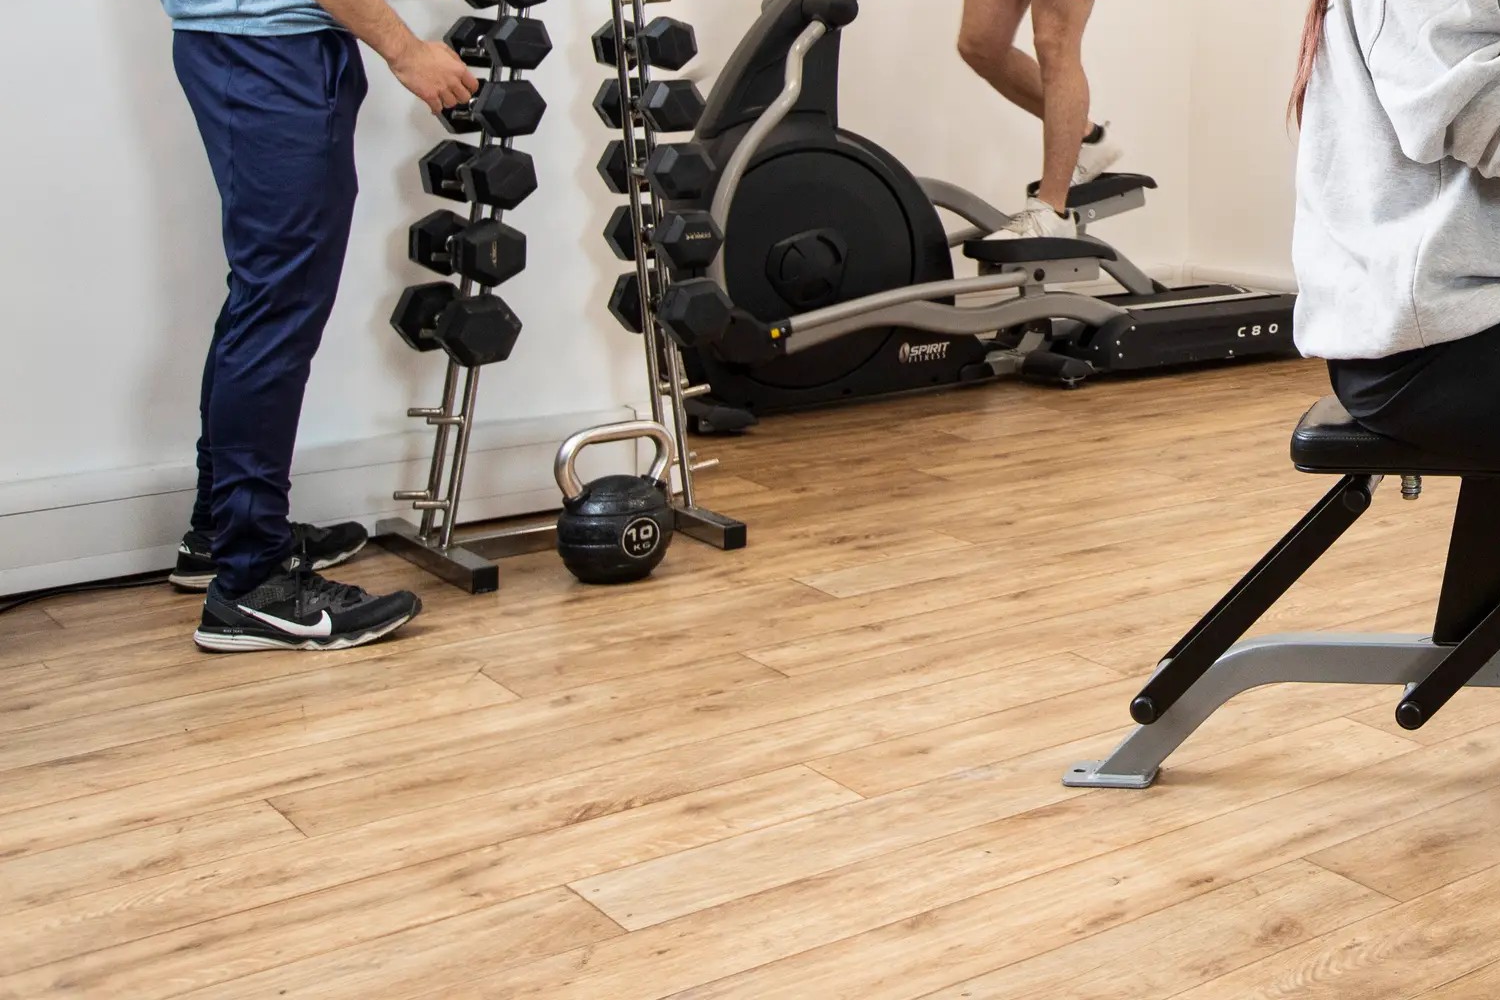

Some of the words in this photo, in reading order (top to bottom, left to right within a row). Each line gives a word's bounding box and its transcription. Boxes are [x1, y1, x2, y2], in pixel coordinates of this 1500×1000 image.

[910, 341, 951, 357] SPIRIT
[627, 524, 653, 542] 10
[633, 541, 651, 551] KG
